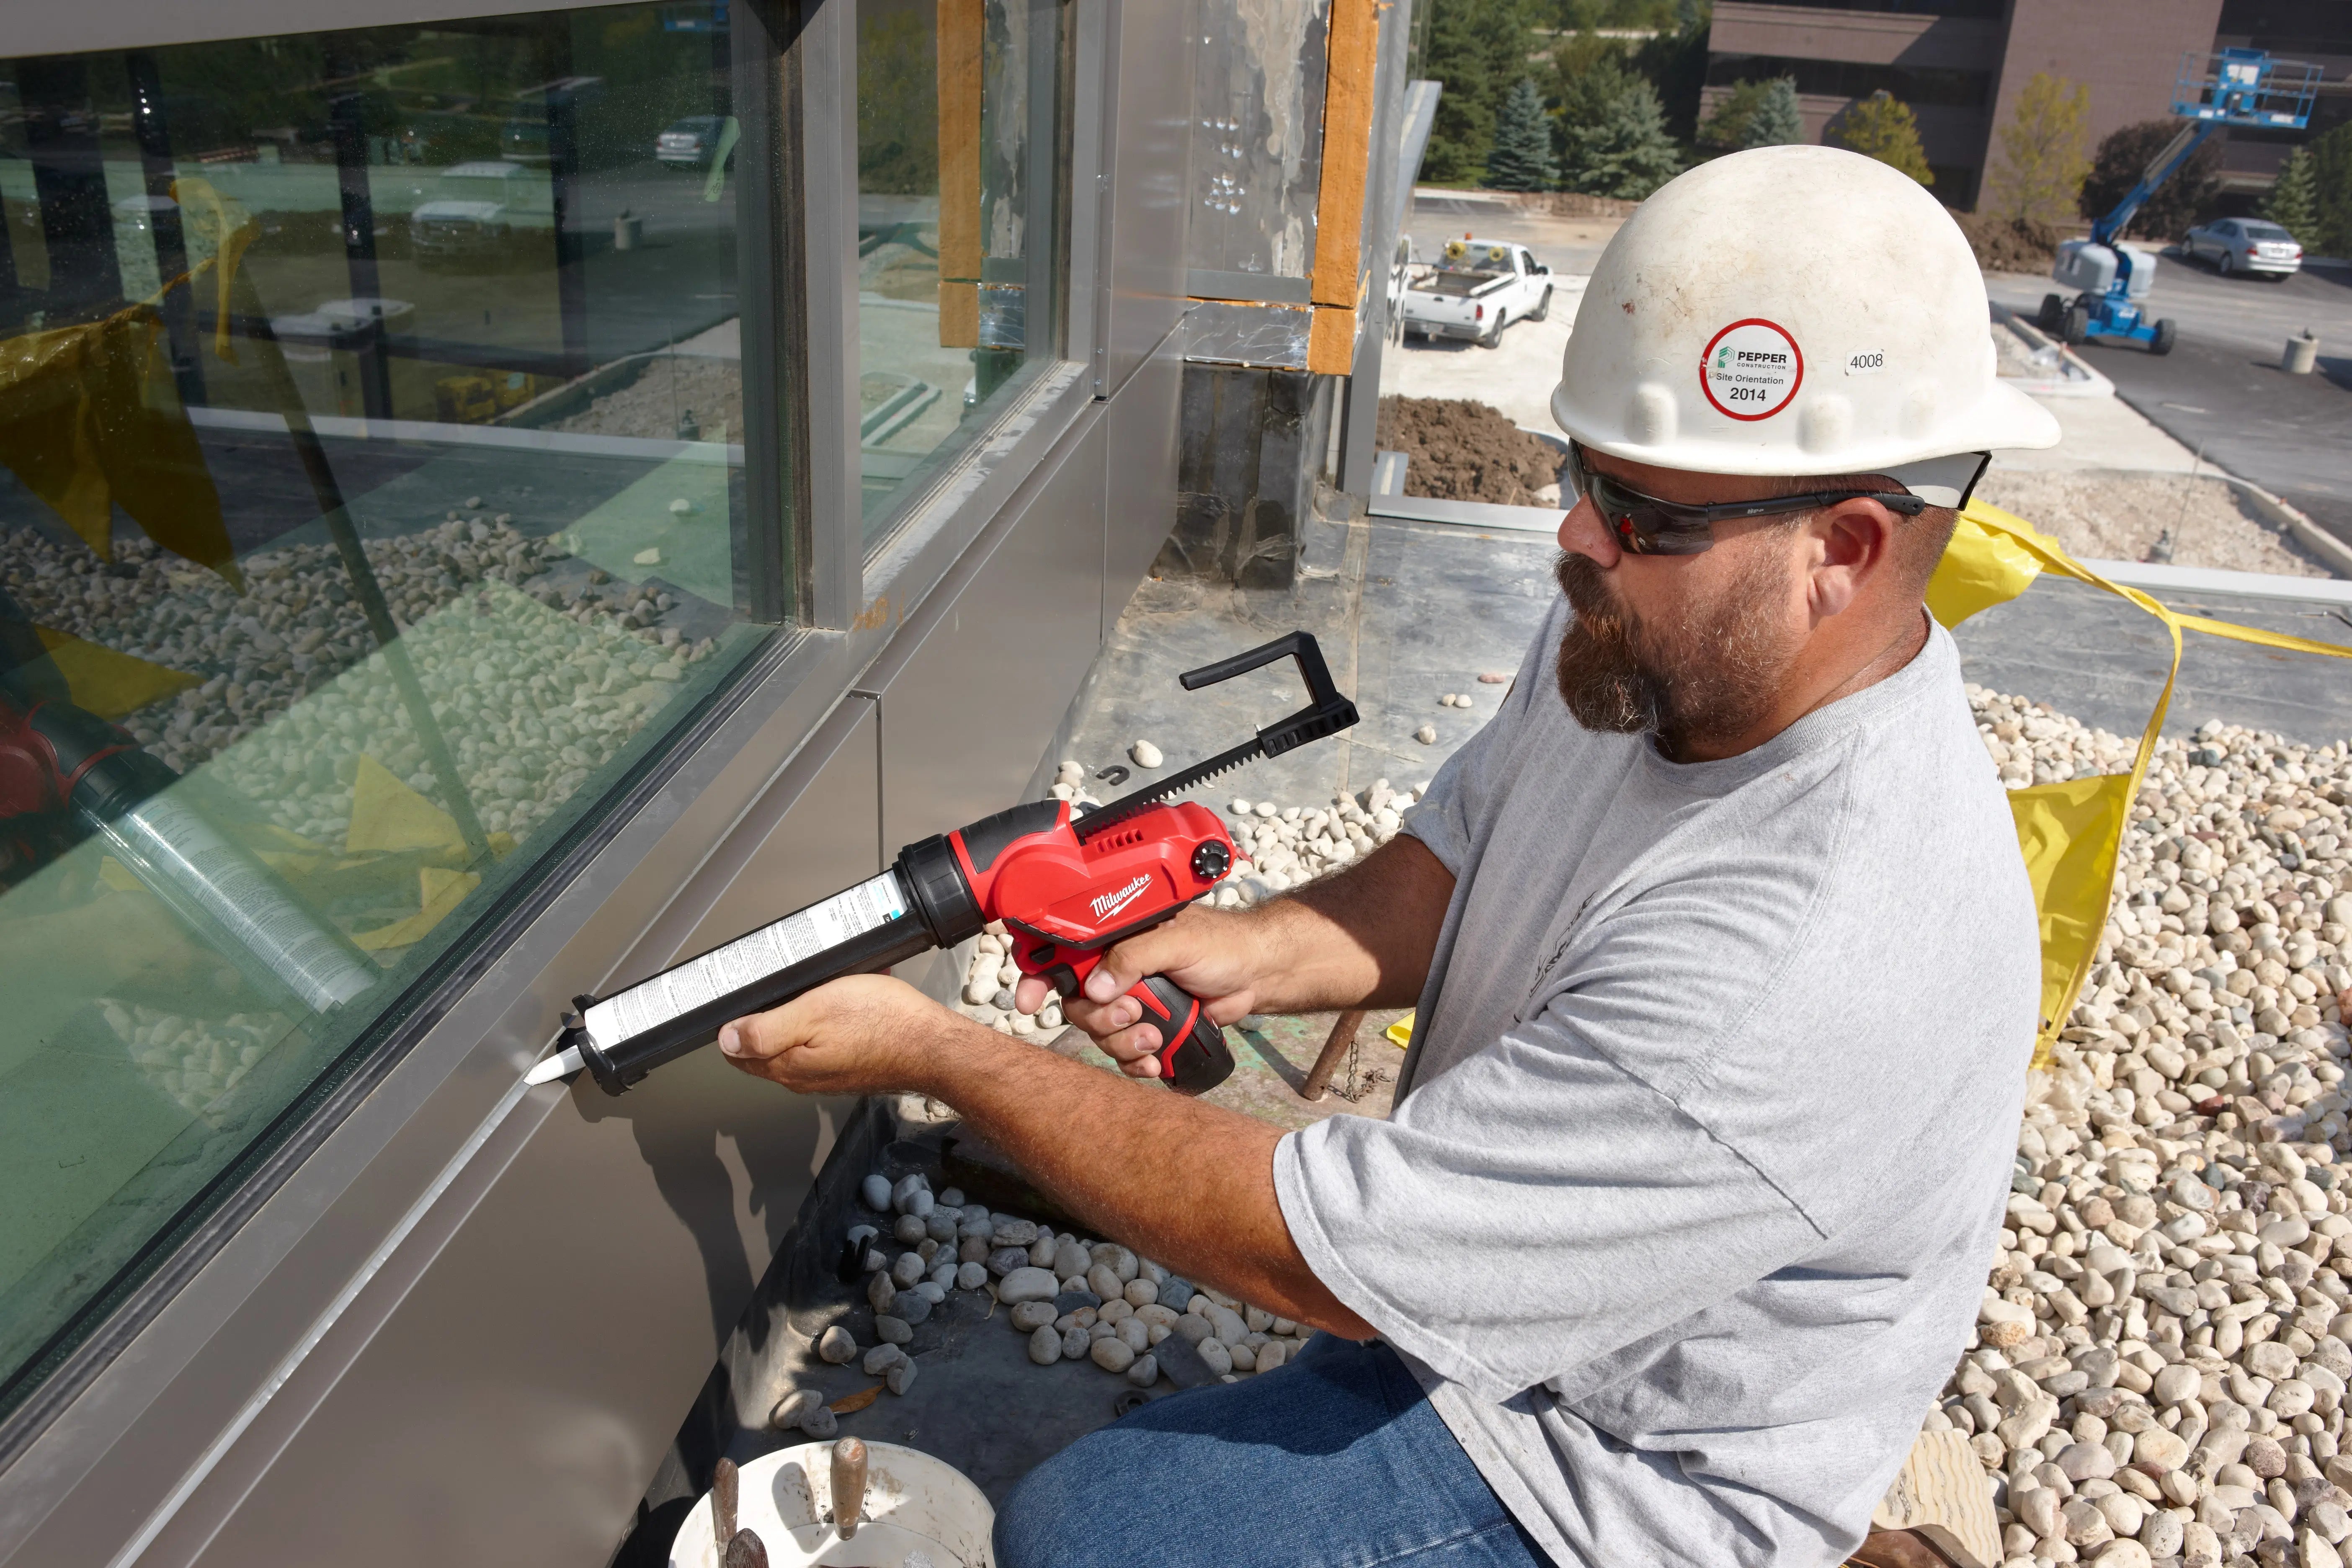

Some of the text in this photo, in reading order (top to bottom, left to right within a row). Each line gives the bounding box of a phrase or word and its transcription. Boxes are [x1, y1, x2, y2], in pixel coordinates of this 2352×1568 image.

[1738, 351, 1787, 363] PEPPER
[1850, 353, 1883, 369] 4008
[1736, 374, 1783, 384] Orientation
[1730, 387, 1766, 401] 2014
[1089, 874, 1152, 917] Milwaukee
[668, 985, 679, 1008] INFORMATION
